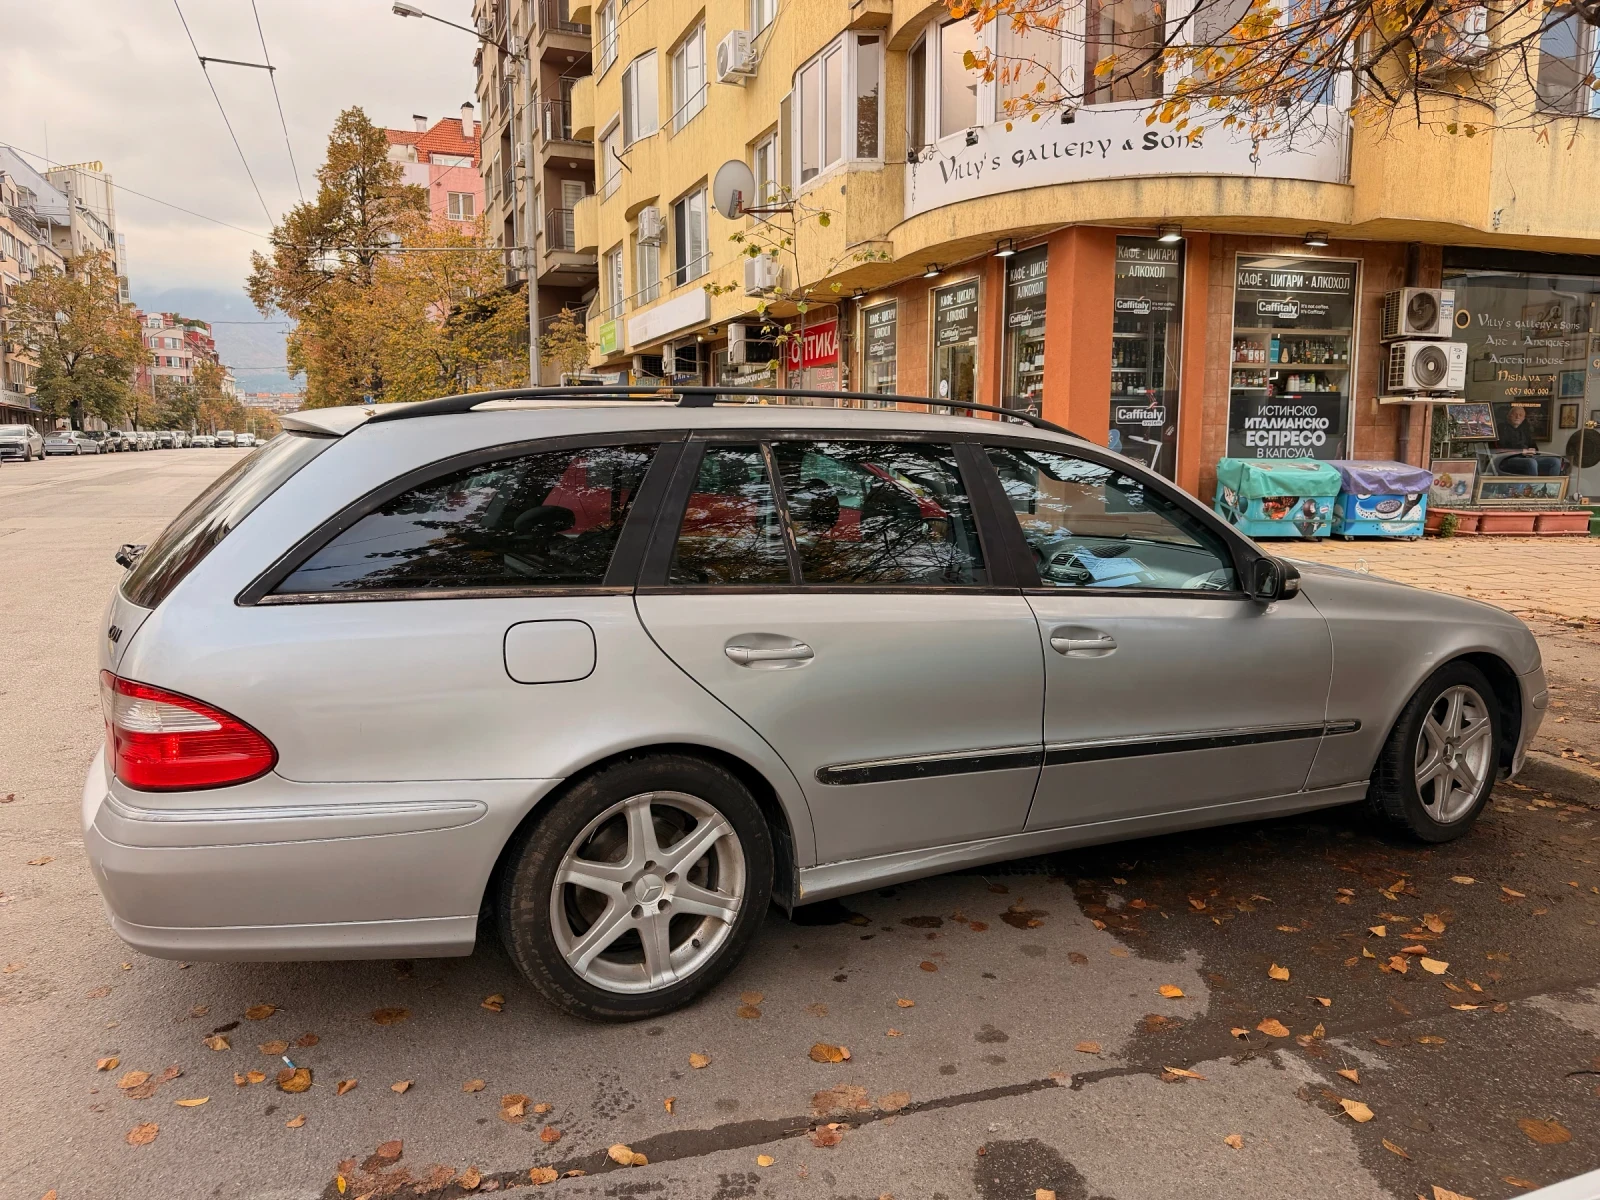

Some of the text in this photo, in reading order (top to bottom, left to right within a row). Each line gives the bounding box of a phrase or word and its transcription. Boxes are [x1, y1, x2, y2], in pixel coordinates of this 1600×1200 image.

[1121, 139, 1134, 151] &
[1118, 245, 1177, 261] КАФЕ ЦИГАРИ
[1010, 260, 1048, 282] КАФЕ ЦИГАР
[1128, 265, 1165, 278] АЛКОХОЛ
[1238, 272, 1350, 290] КАФЕ ЦИГАРИ АЛКОХОЛ
[1016, 281, 1044, 299] АЛКОХОЛ
[940, 287, 975, 307] КАФЕ ЦИГАРИ
[1117, 300, 1149, 312] Caffitaly
[1259, 301, 1297, 314] Caffitaly
[1010, 311, 1032, 325] Caffitaly
[1118, 408, 1163, 421] Caffitaly
[1258, 405, 1317, 416] ИСТИНСКО
[1244, 417, 1329, 429] ИТАЛИАНСКО
[1246, 430, 1326, 447] ЕСПРЕСО
[1257, 448, 1314, 458] В КАПСУЛА
